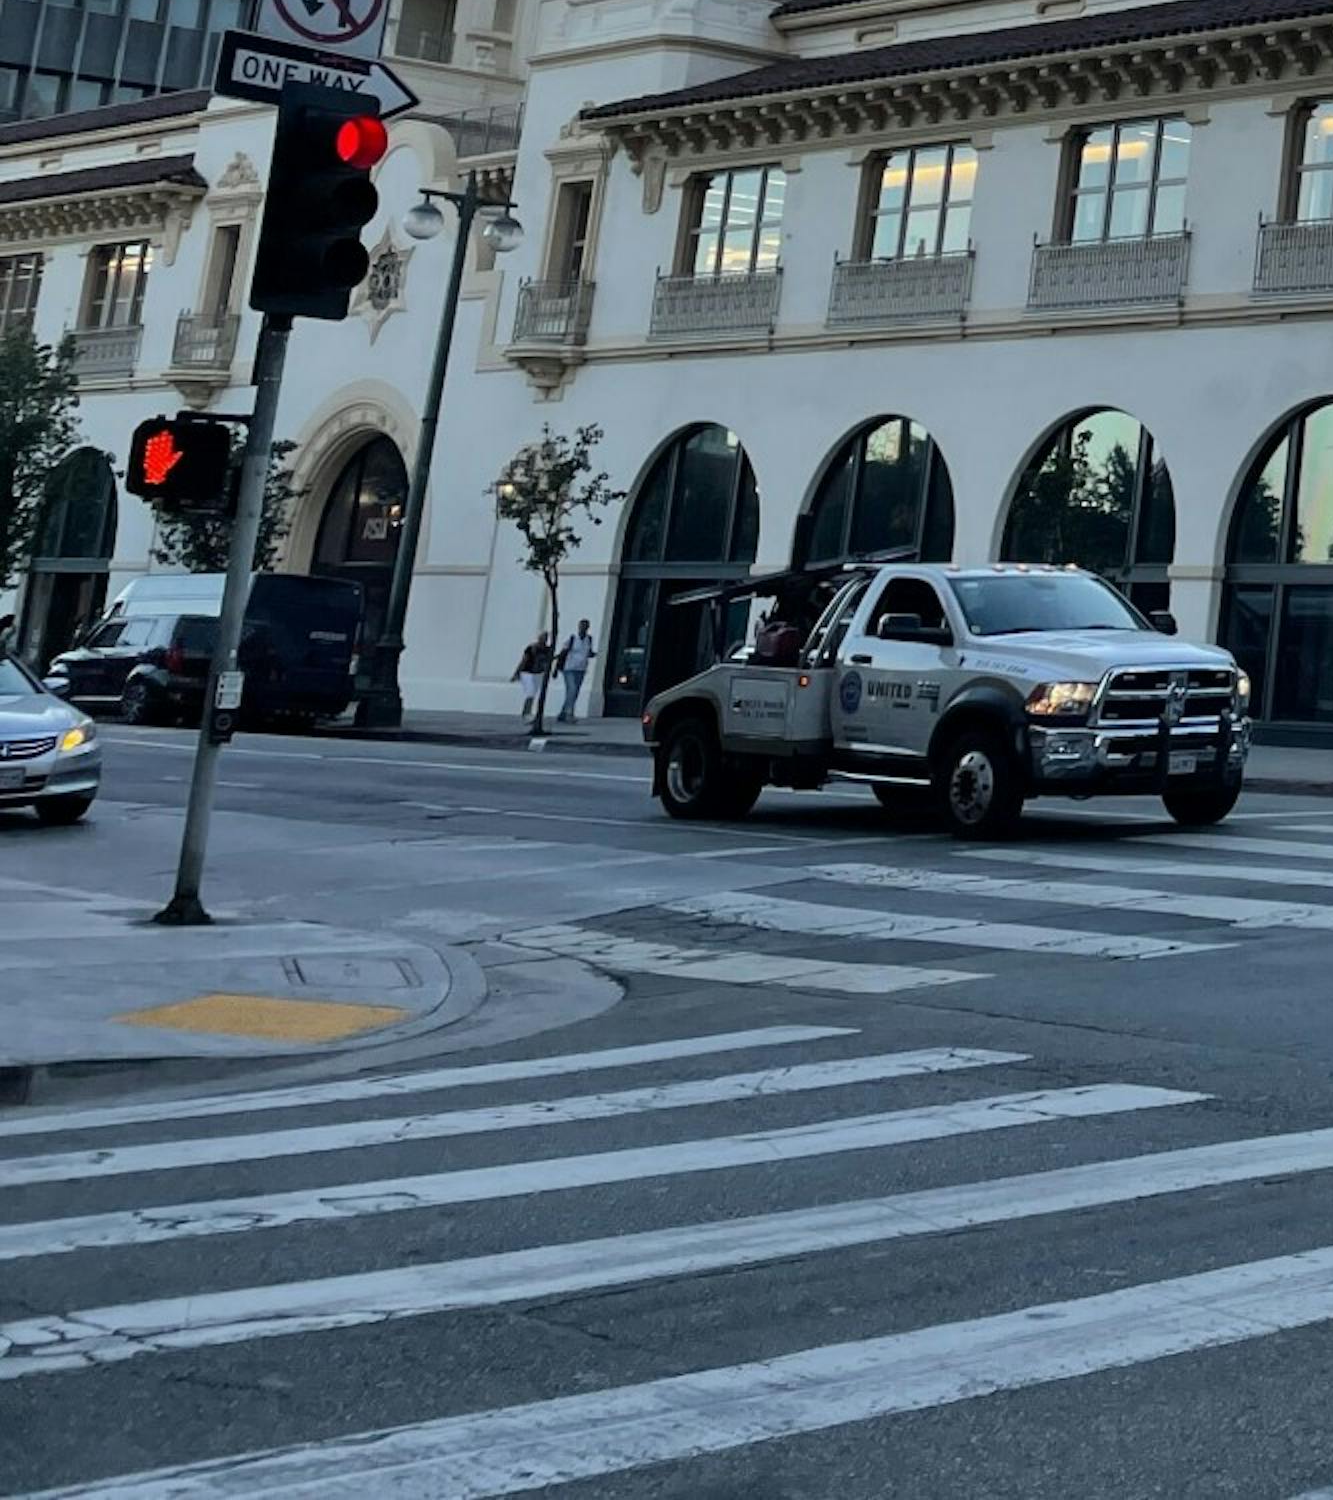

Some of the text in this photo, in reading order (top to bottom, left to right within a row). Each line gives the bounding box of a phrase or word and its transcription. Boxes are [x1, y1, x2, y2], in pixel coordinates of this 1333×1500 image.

[242, 55, 366, 94] ONE WAY
[867, 679, 912, 699] UNITED
